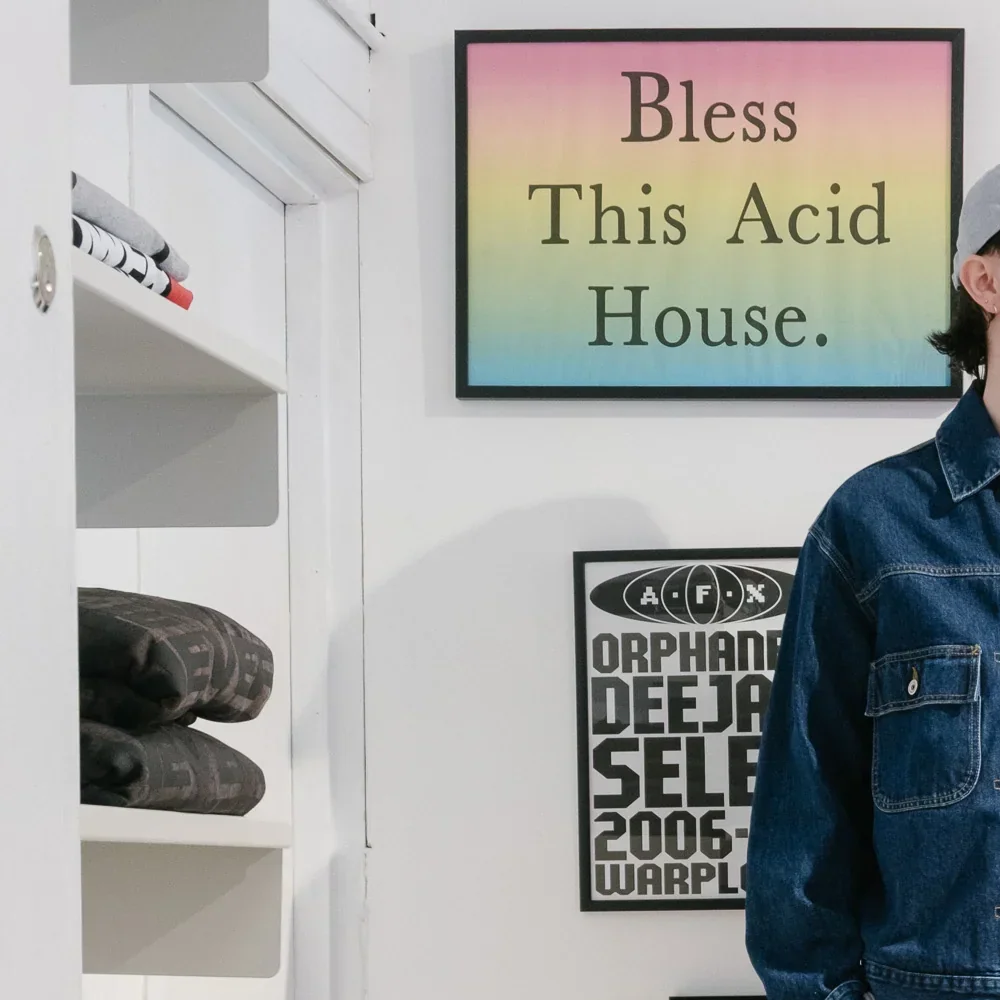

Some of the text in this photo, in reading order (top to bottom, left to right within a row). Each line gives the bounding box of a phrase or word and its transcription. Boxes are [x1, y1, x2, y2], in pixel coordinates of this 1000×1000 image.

[621, 71, 798, 143] Bless
[528, 180, 891, 246] This Acid
[588, 286, 828, 348] House.
[591, 674, 773, 735] DEEJA
[593, 736, 763, 809] SELE
[595, 863, 747, 896] WARPL
